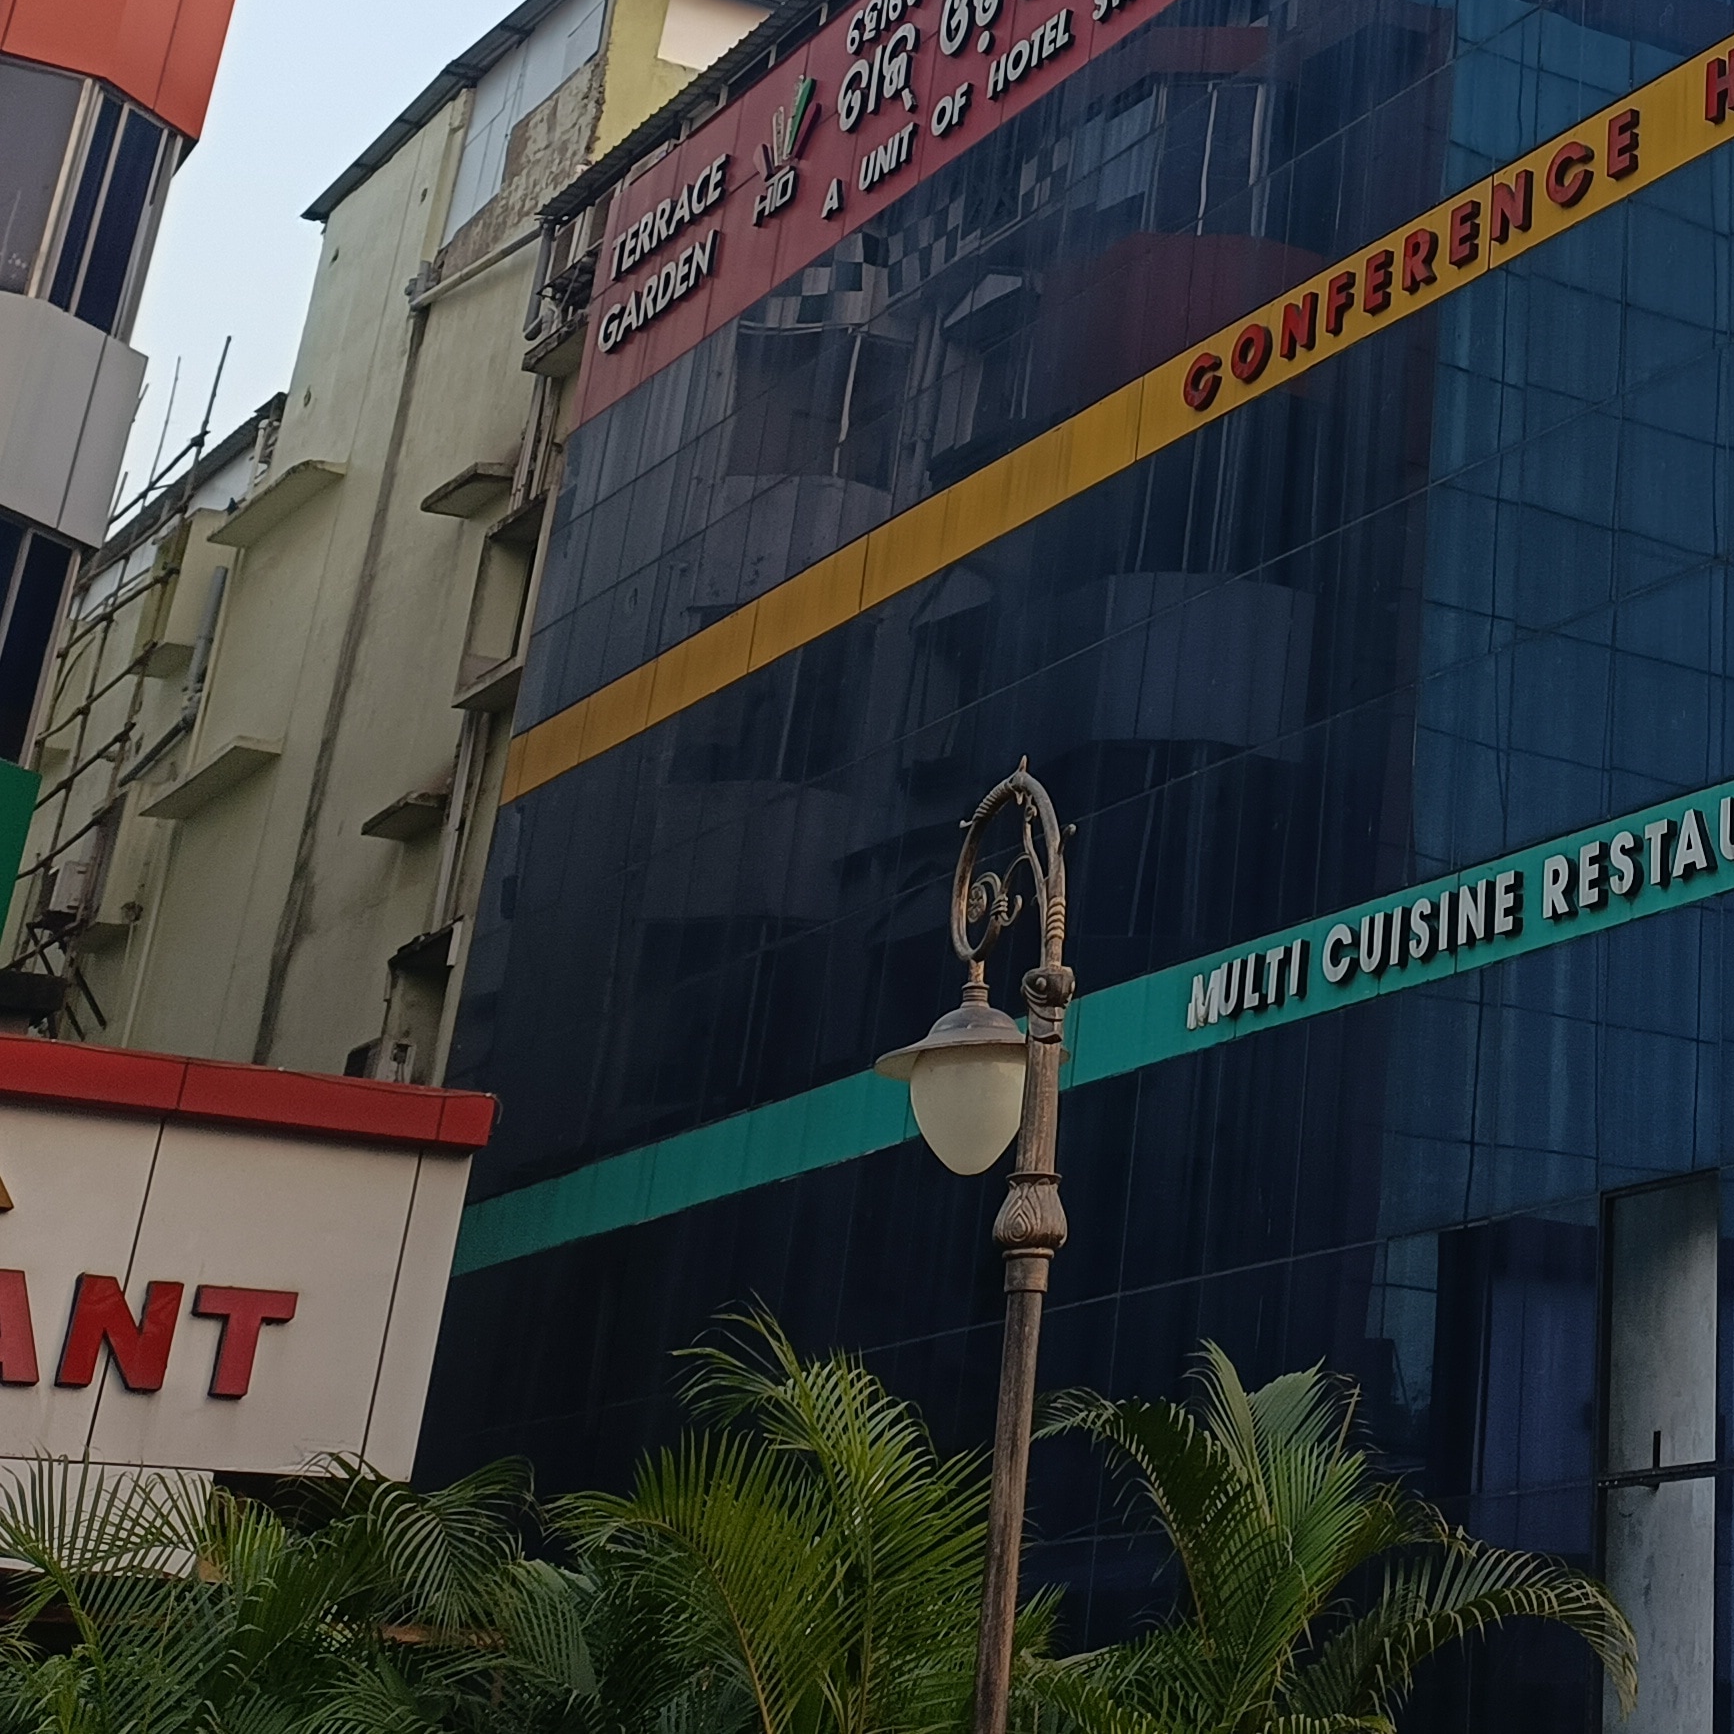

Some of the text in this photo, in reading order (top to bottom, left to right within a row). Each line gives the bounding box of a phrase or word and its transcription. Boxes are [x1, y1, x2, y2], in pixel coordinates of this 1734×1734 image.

[822, 178, 841, 219] A
[858, 123, 915, 191] UNIT
[931, 82, 970, 136] OF
[987, 8, 1069, 99] HOTEL
[598, 230, 718, 353] GARDEN
[611, 154, 729, 281] TERRACE
[1184, 109, 1640, 410] CONFERENCE
[1187, 939, 1304, 1030] MULTI
[1323, 870, 1518, 984] CUISINE
